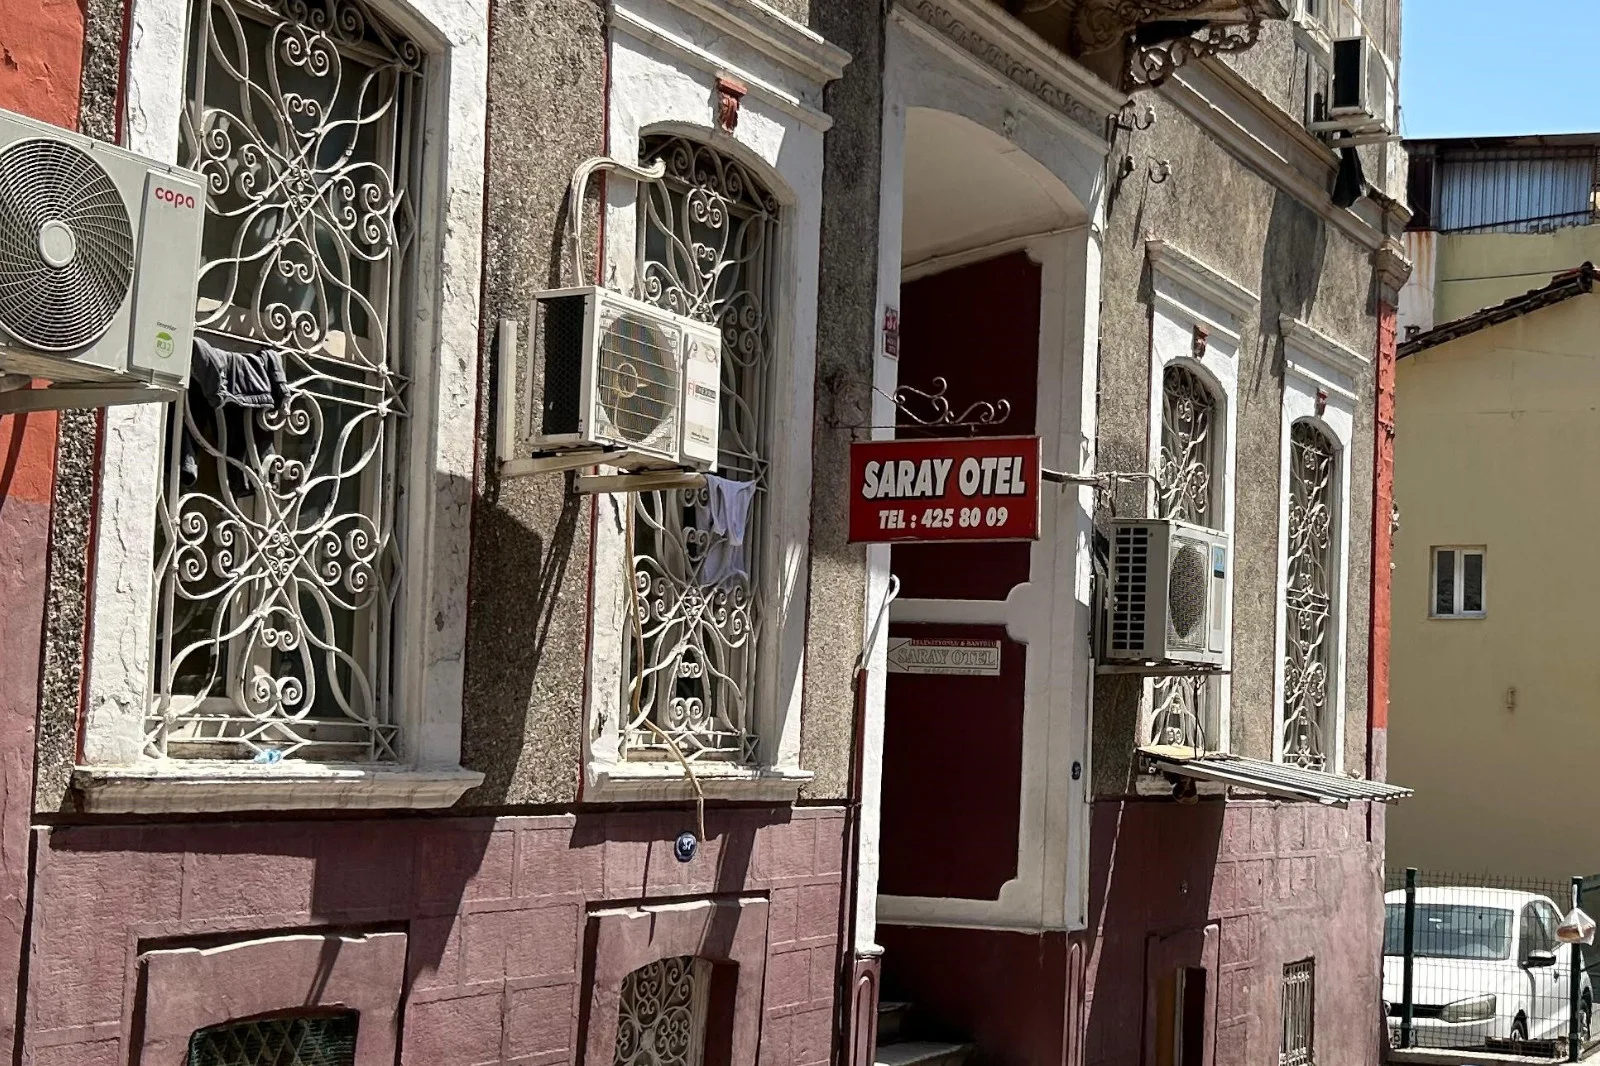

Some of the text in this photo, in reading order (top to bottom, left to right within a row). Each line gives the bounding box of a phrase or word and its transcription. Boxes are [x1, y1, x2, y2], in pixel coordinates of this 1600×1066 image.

[155, 187, 195, 209] copa
[156, 340, 172, 351] R32
[862, 456, 1026, 499] SARAY OTEL
[879, 509, 906, 529] TEL
[921, 508, 954, 528] 425
[959, 507, 981, 528] 80
[985, 506, 1008, 527] 09
[898, 647, 996, 666] SARAY OTEL
